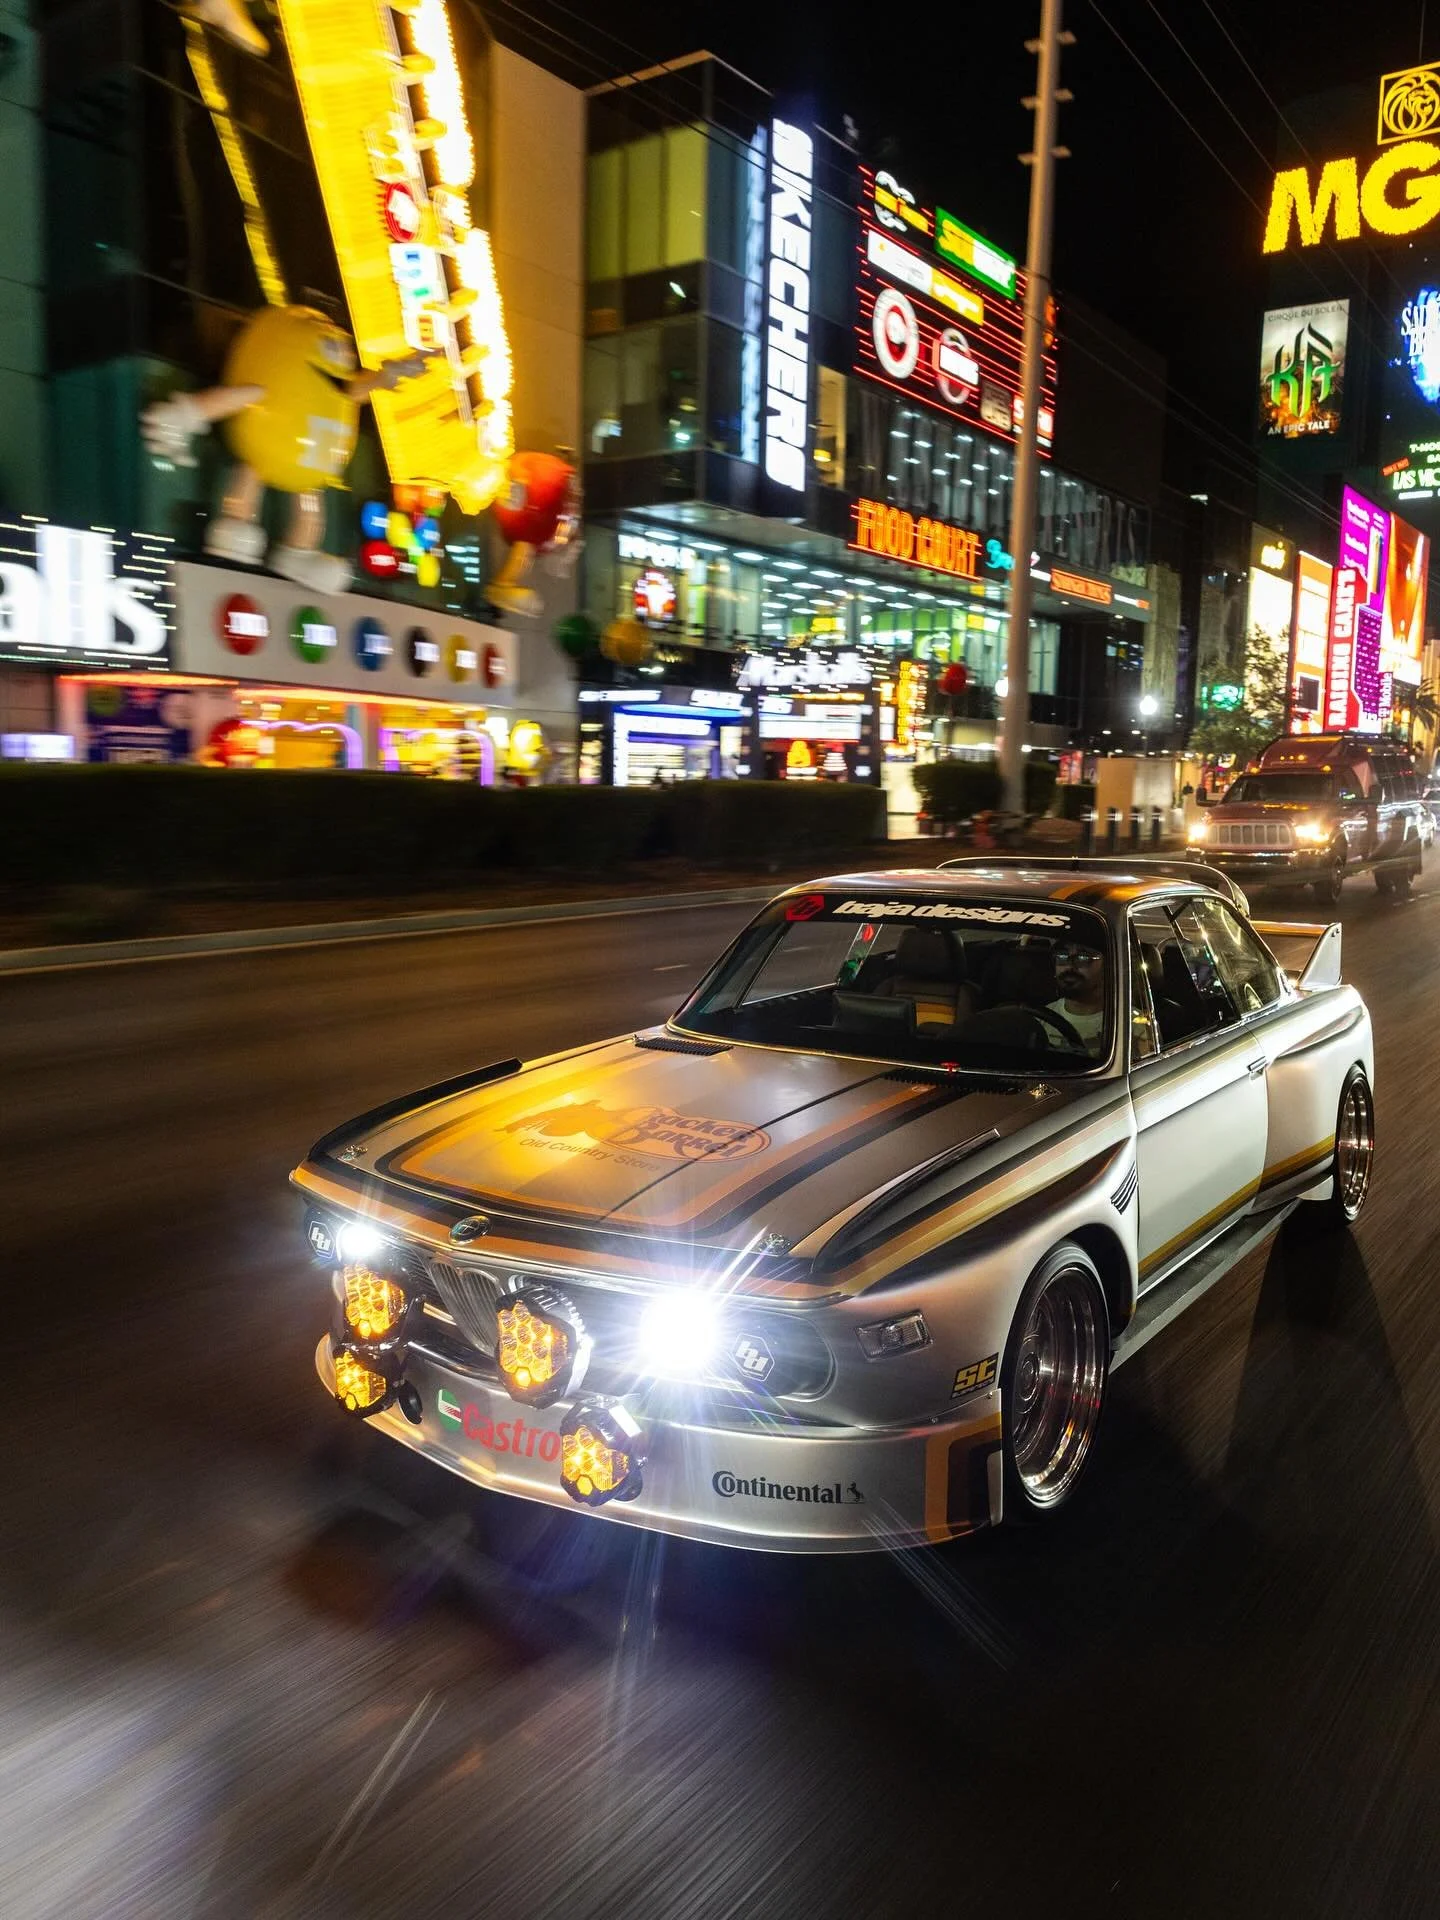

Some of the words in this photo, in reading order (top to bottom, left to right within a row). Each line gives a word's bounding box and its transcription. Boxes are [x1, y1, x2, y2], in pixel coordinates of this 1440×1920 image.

[1267, 311, 1300, 322] CIRQUE
[1301, 307, 1314, 318] DU
[1267, 426, 1282, 436] AN
[1283, 422, 1305, 433] EPIC
[1307, 420, 1331, 431] TALE
[1409, 441, 1440, 453] T-MO
[857, 498, 914, 560] FOOD
[916, 516, 980, 577] COURT
[1328, 643, 1351, 726] RAISING
[1378, 672, 1393, 708] Mobile
[832, 900, 915, 918] baja
[519, 1138, 549, 1148] Old
[549, 1142, 613, 1161] Country
[614, 1154, 663, 1172] Store
[711, 1470, 842, 1504] Continental
